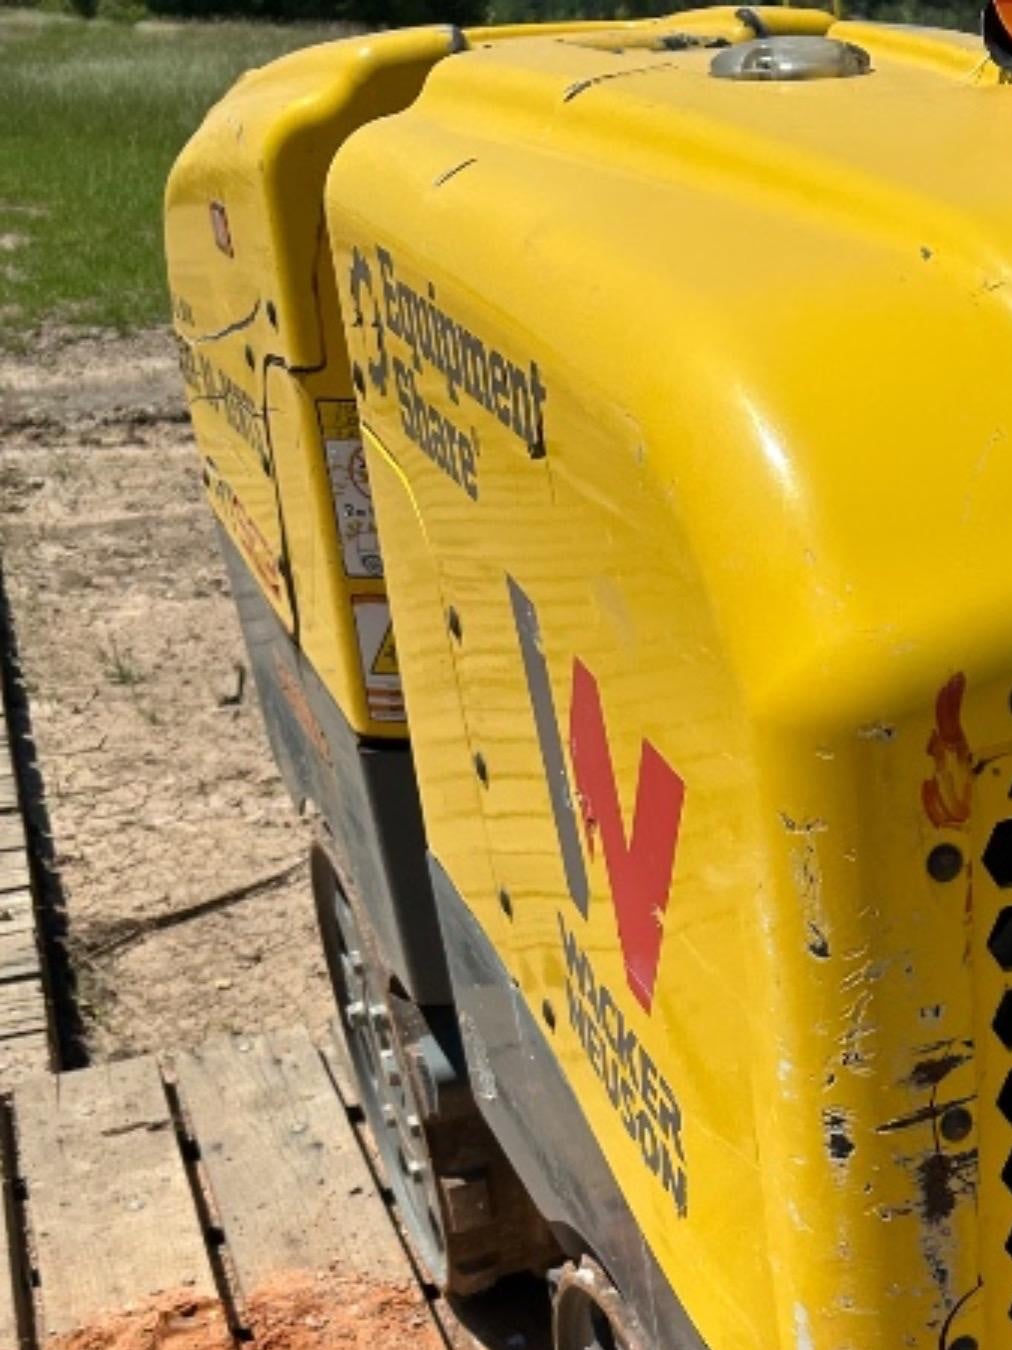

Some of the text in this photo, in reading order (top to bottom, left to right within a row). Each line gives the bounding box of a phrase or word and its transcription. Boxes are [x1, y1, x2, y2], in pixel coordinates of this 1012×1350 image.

[376, 244, 546, 458] Equipment
[557, 911, 686, 1165] WACKER
[566, 976, 687, 1219] NEUSON
